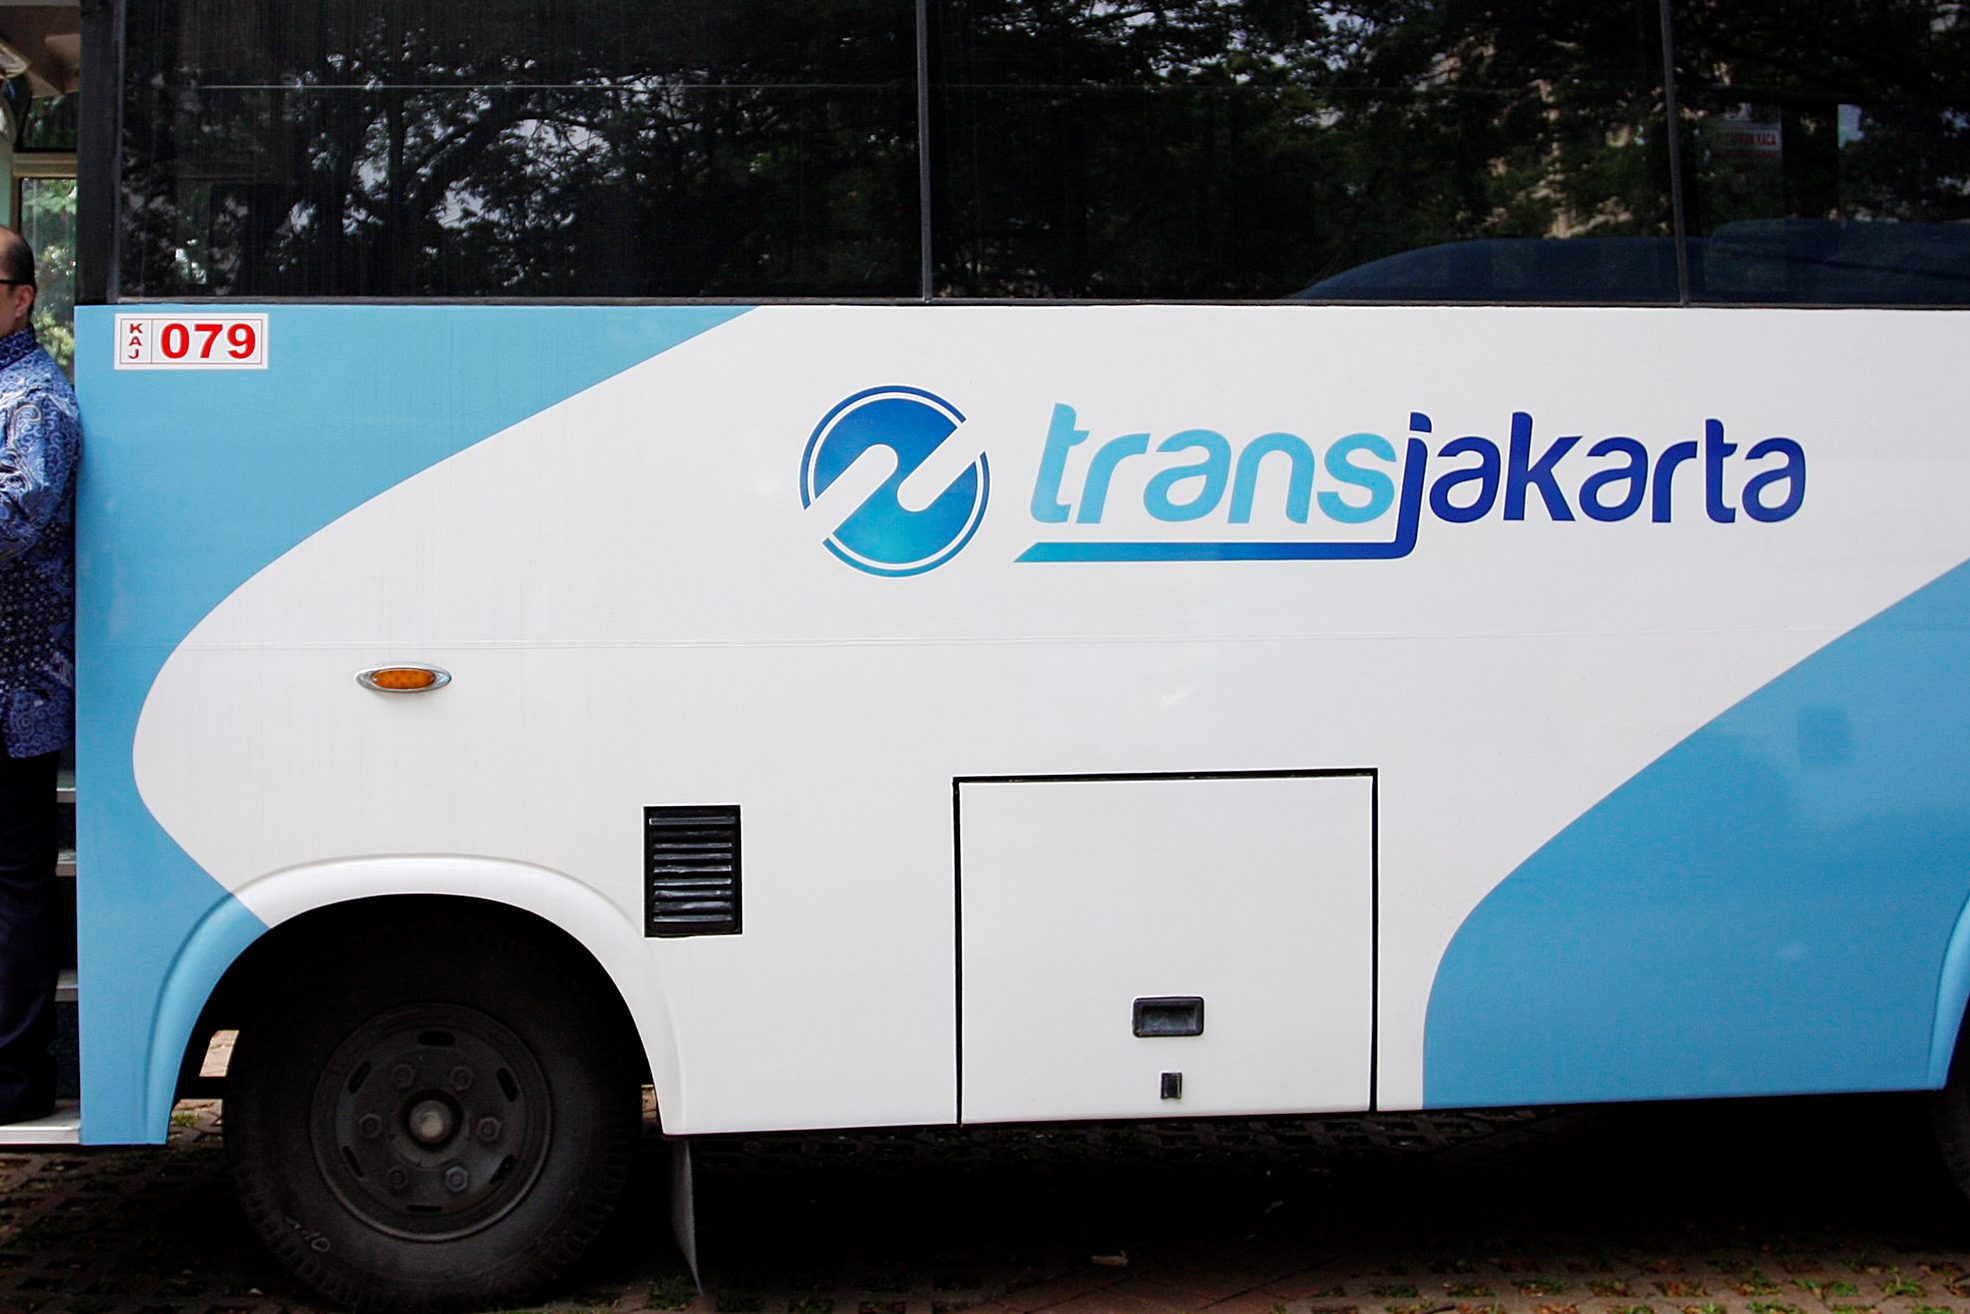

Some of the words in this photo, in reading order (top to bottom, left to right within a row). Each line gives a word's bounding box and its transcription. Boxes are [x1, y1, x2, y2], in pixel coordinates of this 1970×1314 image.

[128, 323, 143, 359] KAJ
[161, 323, 256, 359] 079
[1020, 403, 1807, 564] transjakarta
